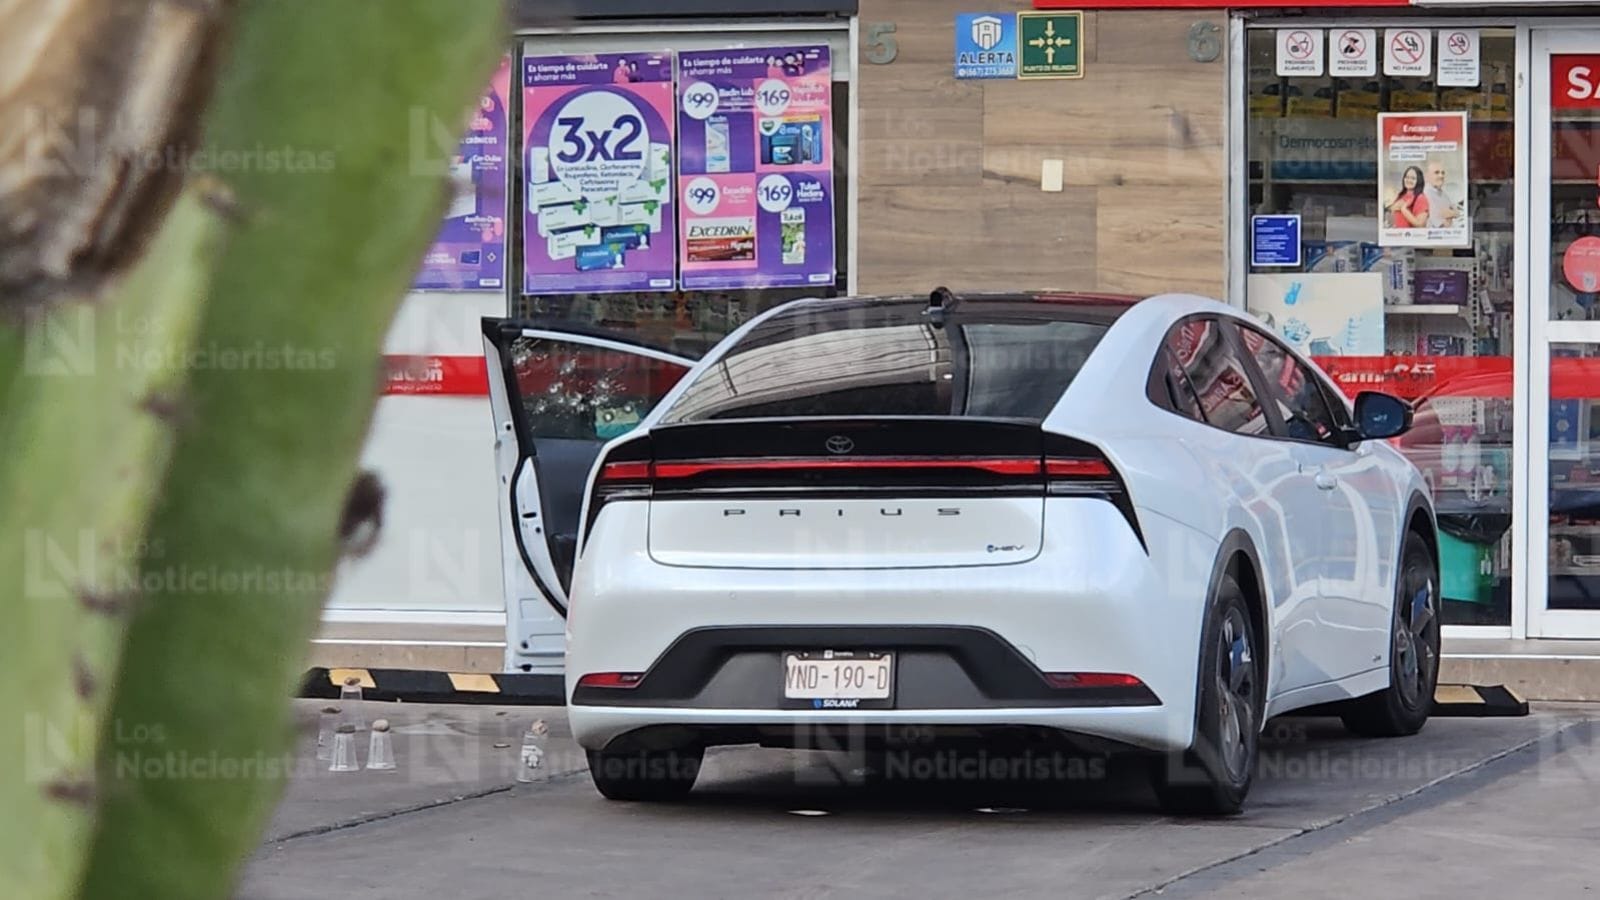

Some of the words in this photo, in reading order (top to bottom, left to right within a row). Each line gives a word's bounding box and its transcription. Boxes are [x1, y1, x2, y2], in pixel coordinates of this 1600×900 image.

[864, 22, 899, 64] 5
[1186, 19, 1222, 63] 6
[683, 59, 692, 67] Es
[693, 58, 720, 69] tiempo
[721, 57, 731, 66] de
[732, 56, 765, 65] cuidarte
[959, 52, 1014, 64] ALERTA
[528, 64, 537, 73] Es
[537, 63, 564, 74] tiempo
[565, 63, 575, 72] de
[576, 62, 608, 71] cuidarte
[683, 69, 688, 77] y
[689, 68, 715, 76] ahorrar
[528, 74, 533, 82] y
[534, 73, 559, 81] ahorrar
[560, 72, 576, 80] más
[687, 92, 714, 109] $99
[756, 89, 790, 106] $169
[556, 114, 642, 164] 3x2
[689, 187, 716, 204] $99
[758, 185, 791, 201] $169
[689, 225, 752, 237] EXCEDRIN
[723, 506, 961, 517] PRIUS
[823, 699, 858, 708] SOLANA
